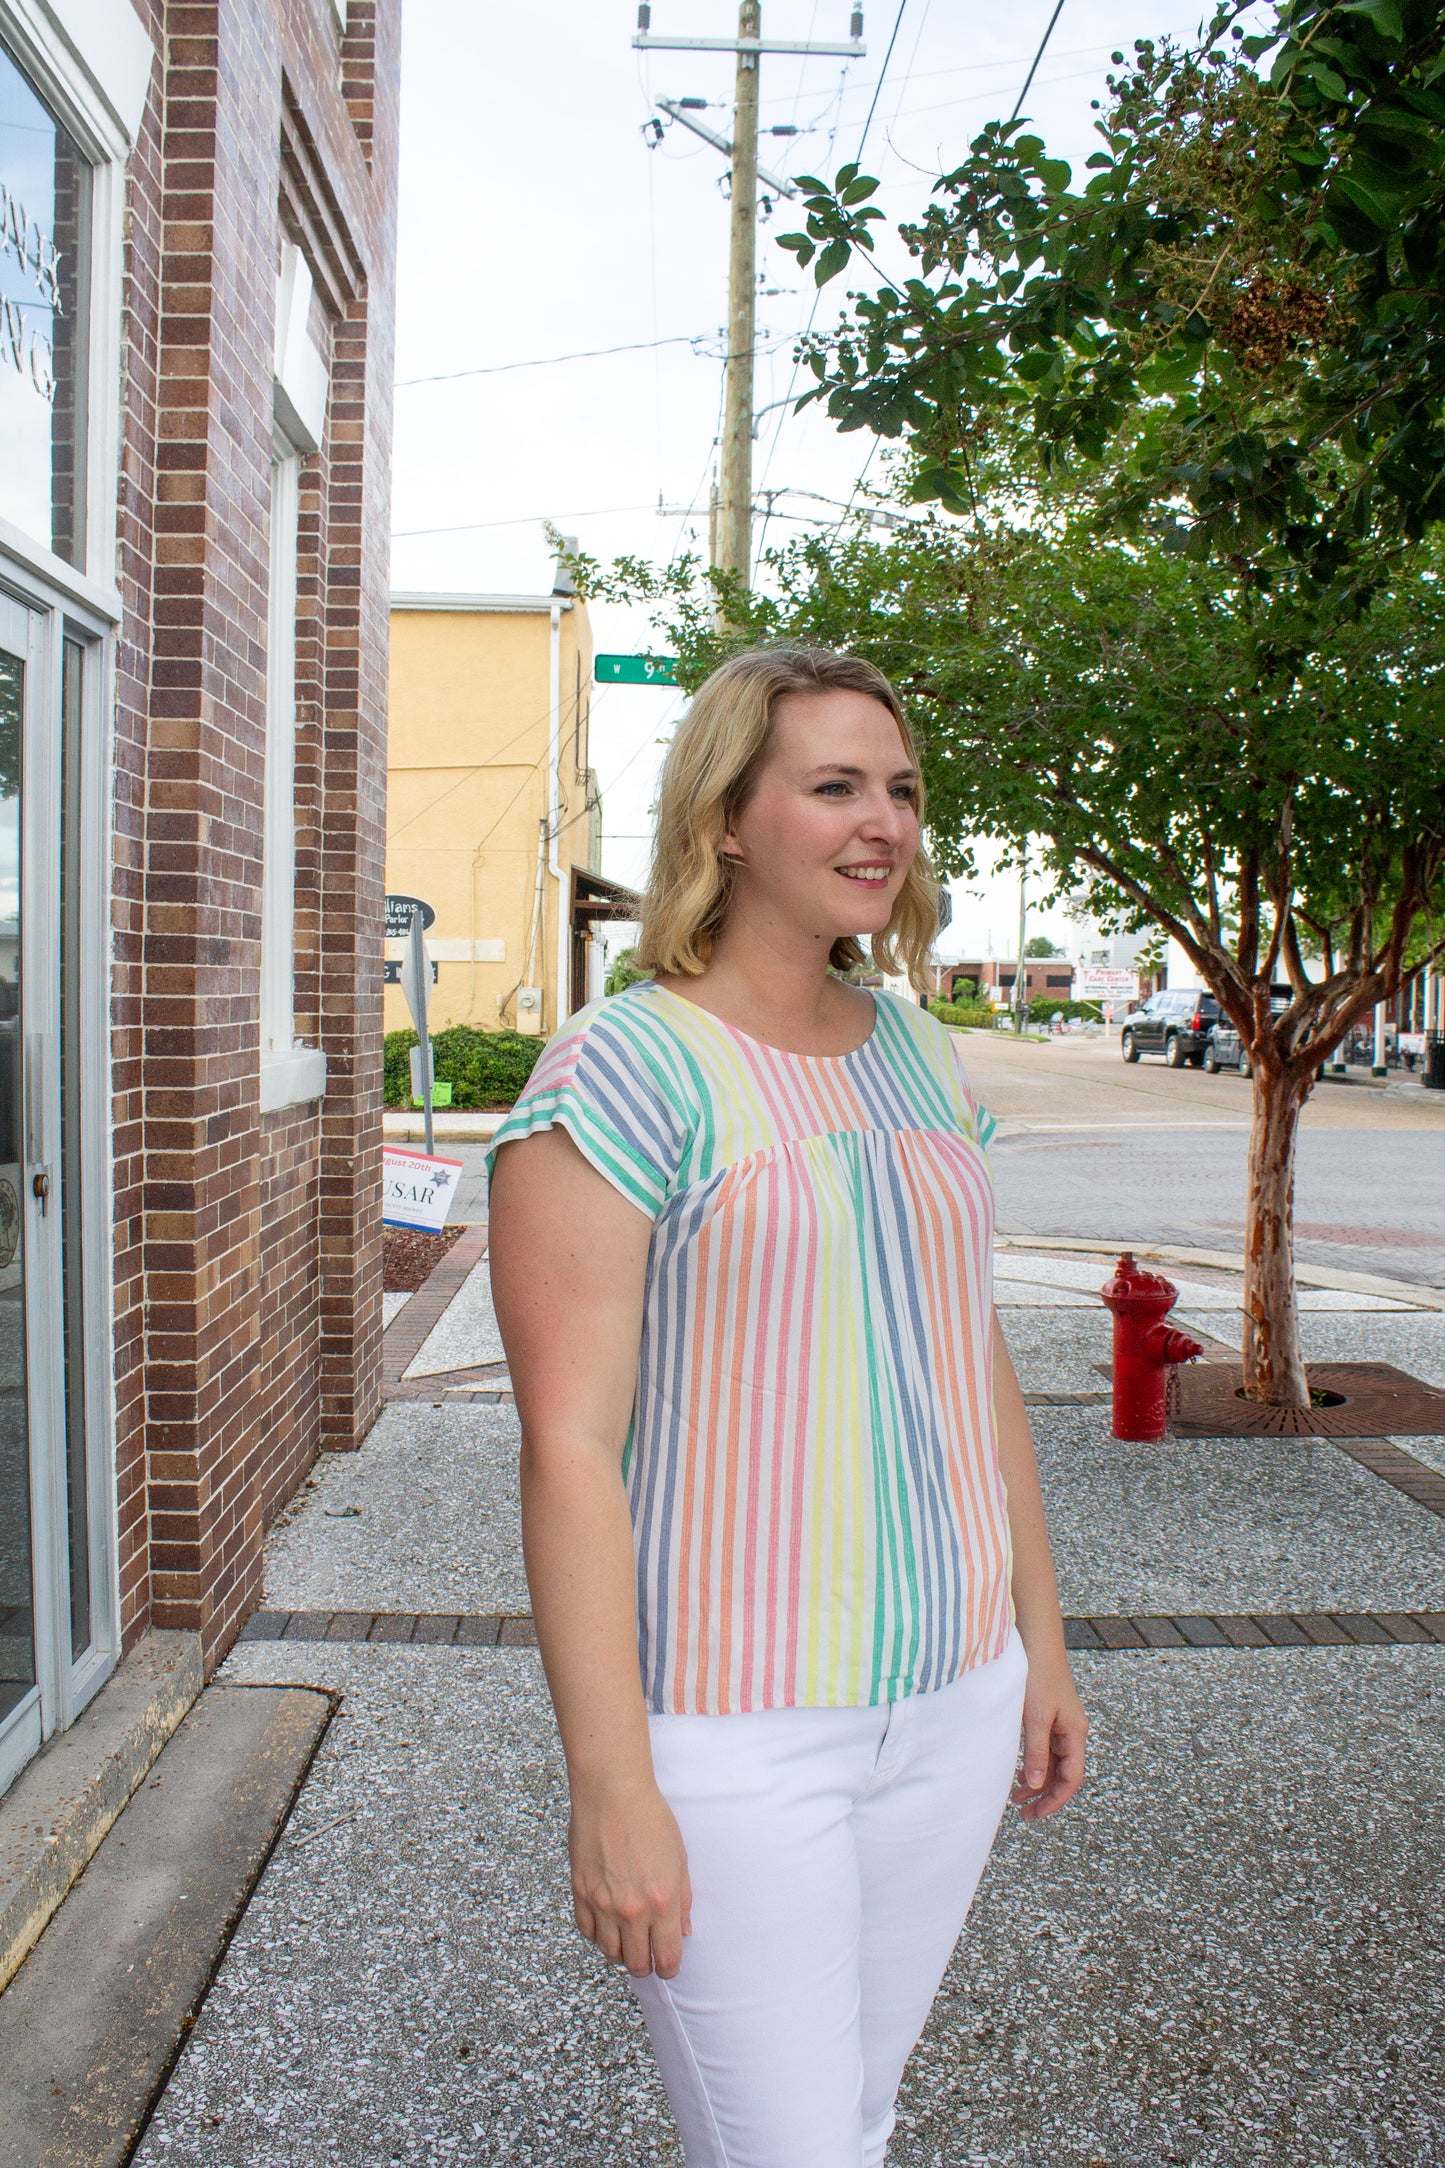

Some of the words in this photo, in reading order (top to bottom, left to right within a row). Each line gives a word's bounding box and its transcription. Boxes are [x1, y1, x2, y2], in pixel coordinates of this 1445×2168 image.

[613, 664, 621, 674] W
[385, 914, 409, 924] Parlor
[408, 1161, 432, 1172] 20th
